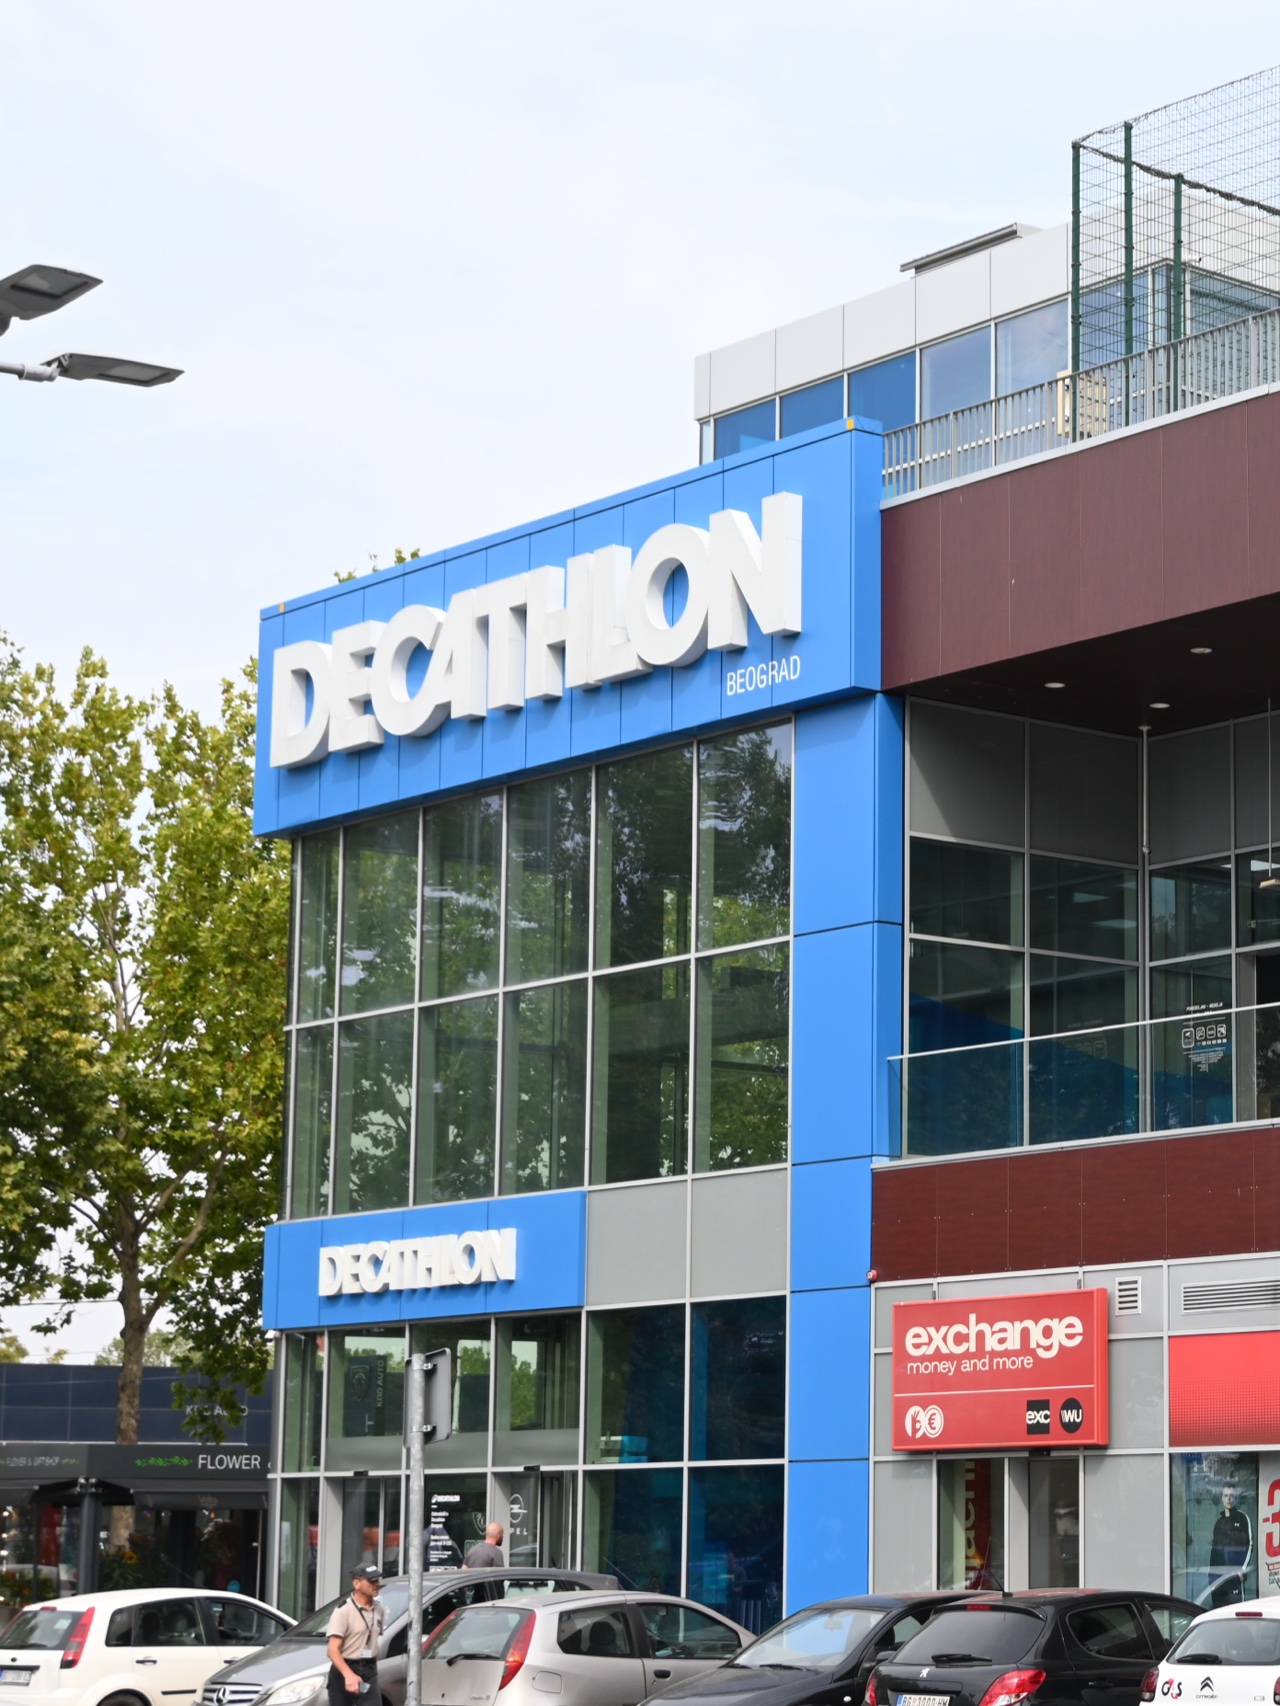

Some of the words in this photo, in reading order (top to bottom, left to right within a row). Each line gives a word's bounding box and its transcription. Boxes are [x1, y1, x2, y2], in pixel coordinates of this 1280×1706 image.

[270, 491, 802, 768] DECATHLON
[726, 655, 801, 696] BEOGRAD
[318, 1228, 517, 1297] DECATHLON
[904, 1313, 1084, 1358] exchange
[907, 1359, 957, 1376] money
[961, 1354, 989, 1372] and
[993, 1355, 1034, 1371] more
[213, 1404, 249, 1417] AO
[1026, 1409, 1050, 1425] exc
[198, 1455, 261, 1470] FLOWER
[509, 1527, 528, 1535] PEL
